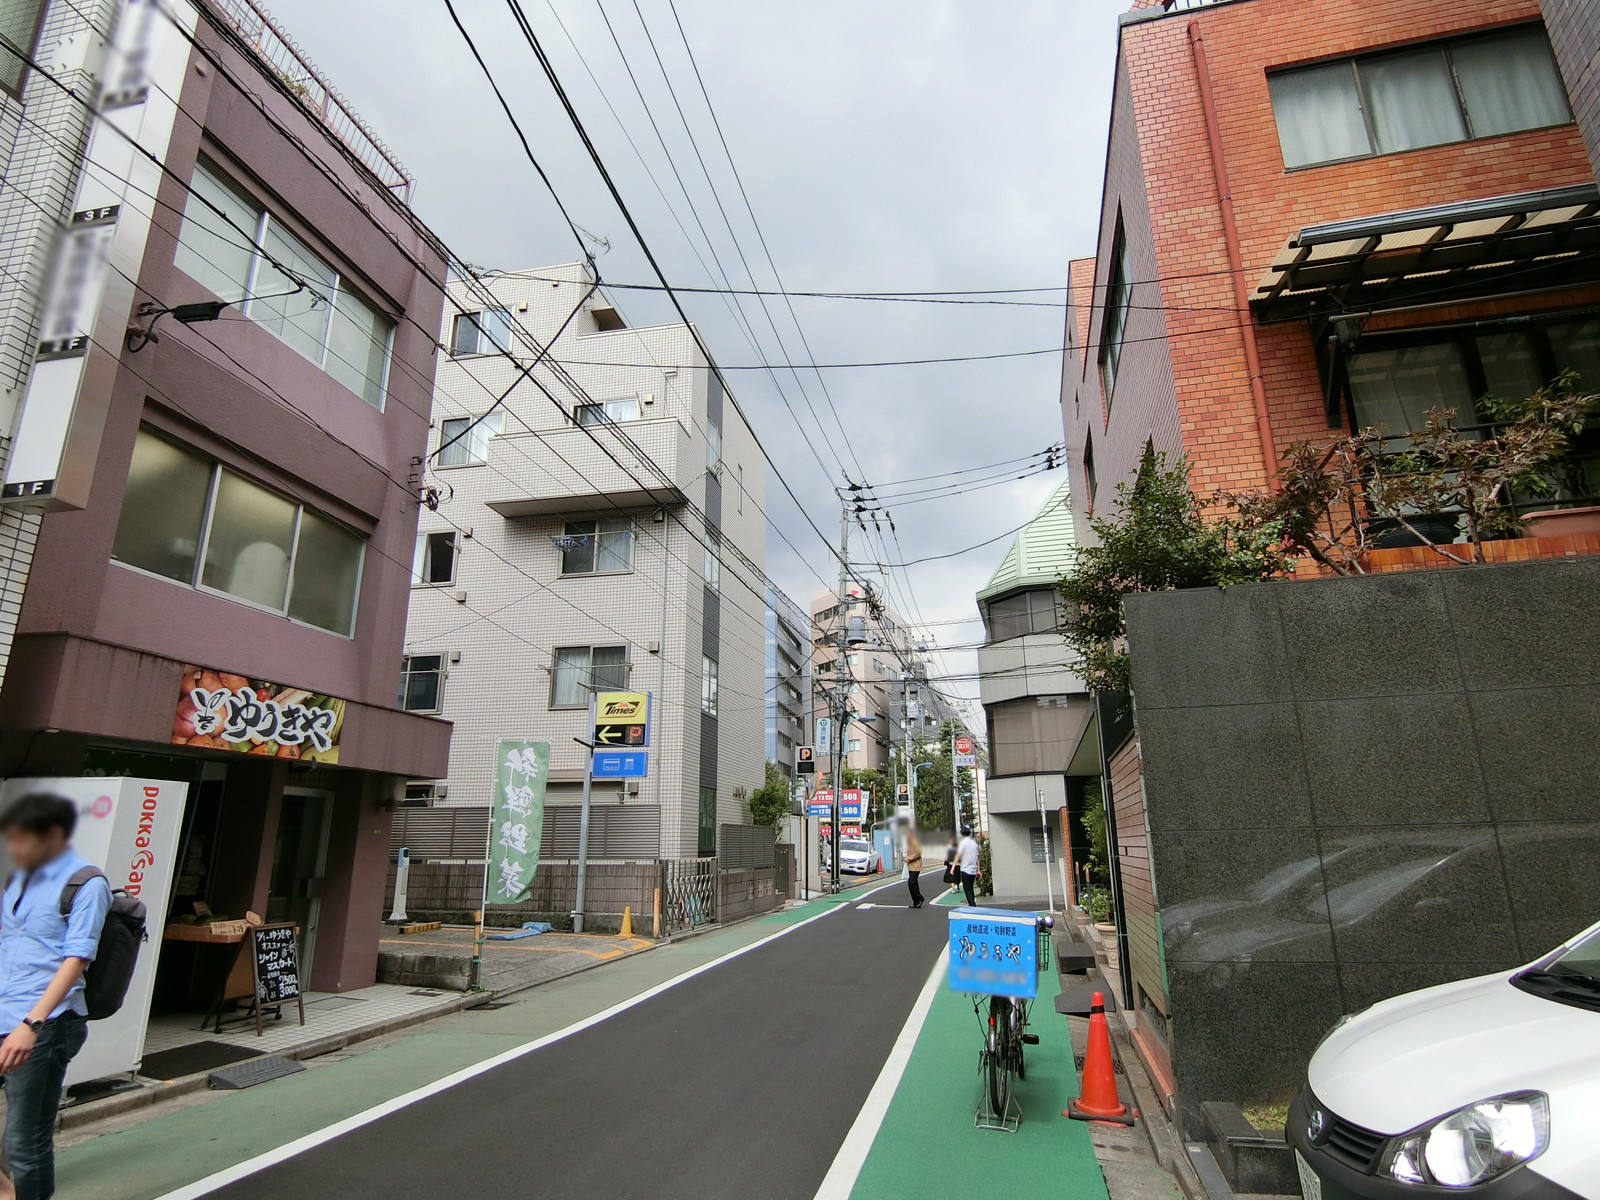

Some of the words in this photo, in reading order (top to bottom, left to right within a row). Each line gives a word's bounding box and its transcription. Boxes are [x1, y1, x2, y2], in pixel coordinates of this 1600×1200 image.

[604, 701, 640, 715] Times
[223, 688, 333, 750] ゆうきや
[630, 726, 642, 744] P
[801, 749, 811, 760] P
